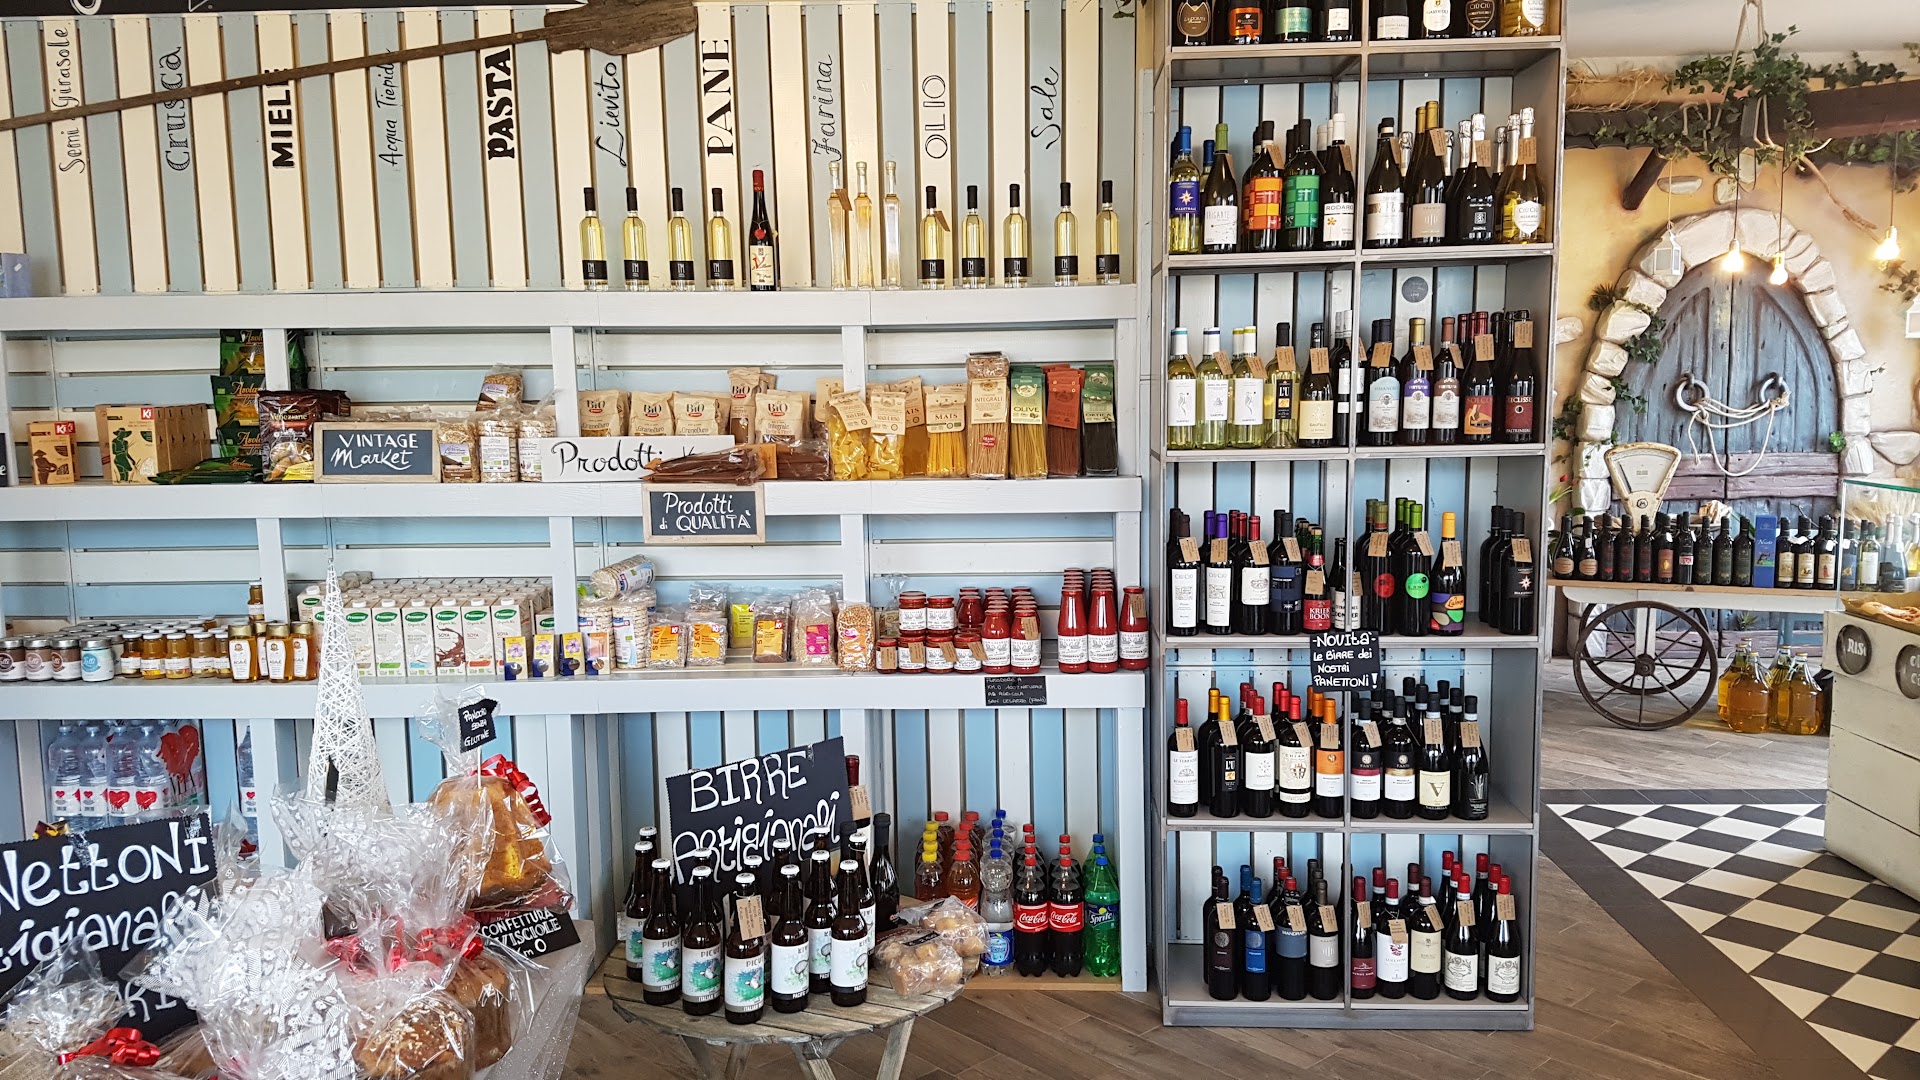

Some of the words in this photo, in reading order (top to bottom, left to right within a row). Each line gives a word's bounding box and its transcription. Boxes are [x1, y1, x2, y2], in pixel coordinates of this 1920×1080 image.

[47, 26, 80, 108] Girasole
[374, 48, 397, 109] Tiepid
[159, 46, 191, 171] Crusca
[484, 48, 515, 160] PASTA
[594, 61, 628, 168] Lievito
[701, 39, 734, 157] PANE
[922, 74, 948, 159] OLIO
[1030, 66, 1061, 149] Sale
[59, 127, 86, 174] Semi
[378, 119, 404, 167] Acqua
[906, 407, 920, 415] AIS
[330, 447, 413, 471] Market
[339, 433, 419, 449] VINTAGE
[659, 519, 668, 530] di
[675, 509, 751, 533] QUALITÀ
[662, 492, 734, 515] Prodotti
[1358, 648, 1373, 659] dei
[464, 729, 490, 747] GLUTINE
[690, 751, 807, 813] BIRRE
[481, 906, 554, 937] CONFETTURA
[494, 918, 561, 947] VISCIOLE
[1089, 911, 1113, 925] Sprite
